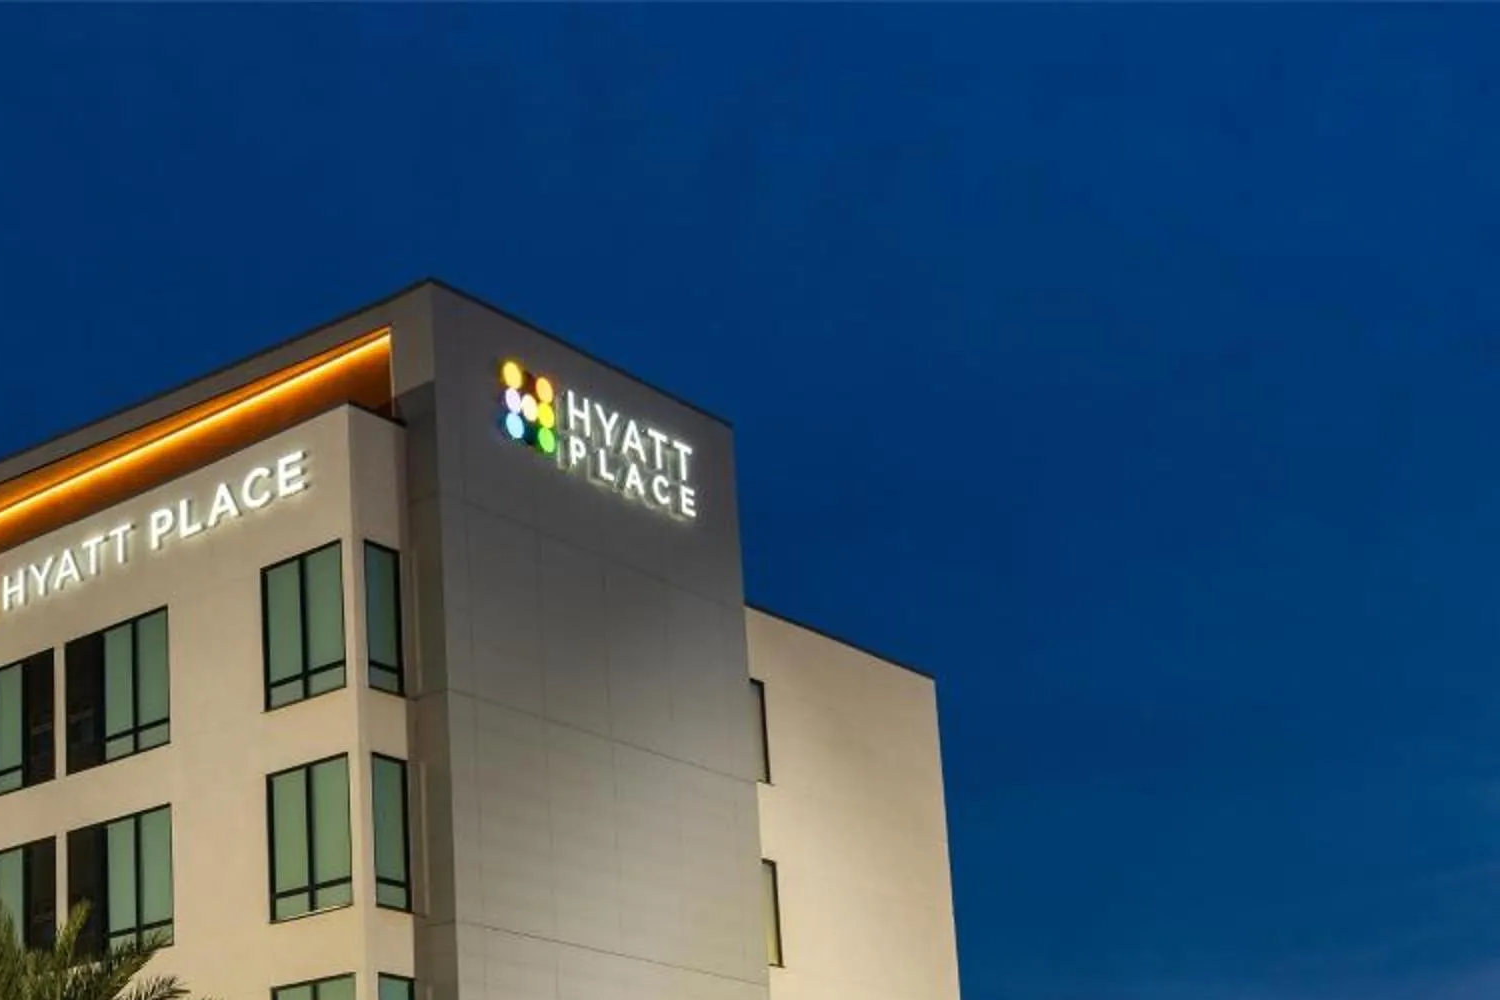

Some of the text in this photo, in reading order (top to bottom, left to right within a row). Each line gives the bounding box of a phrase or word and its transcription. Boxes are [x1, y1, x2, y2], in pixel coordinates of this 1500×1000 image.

[567, 389, 693, 481] HYATT
[569, 435, 697, 517] PLACE
[2, 450, 308, 611] HYATT PLACE
